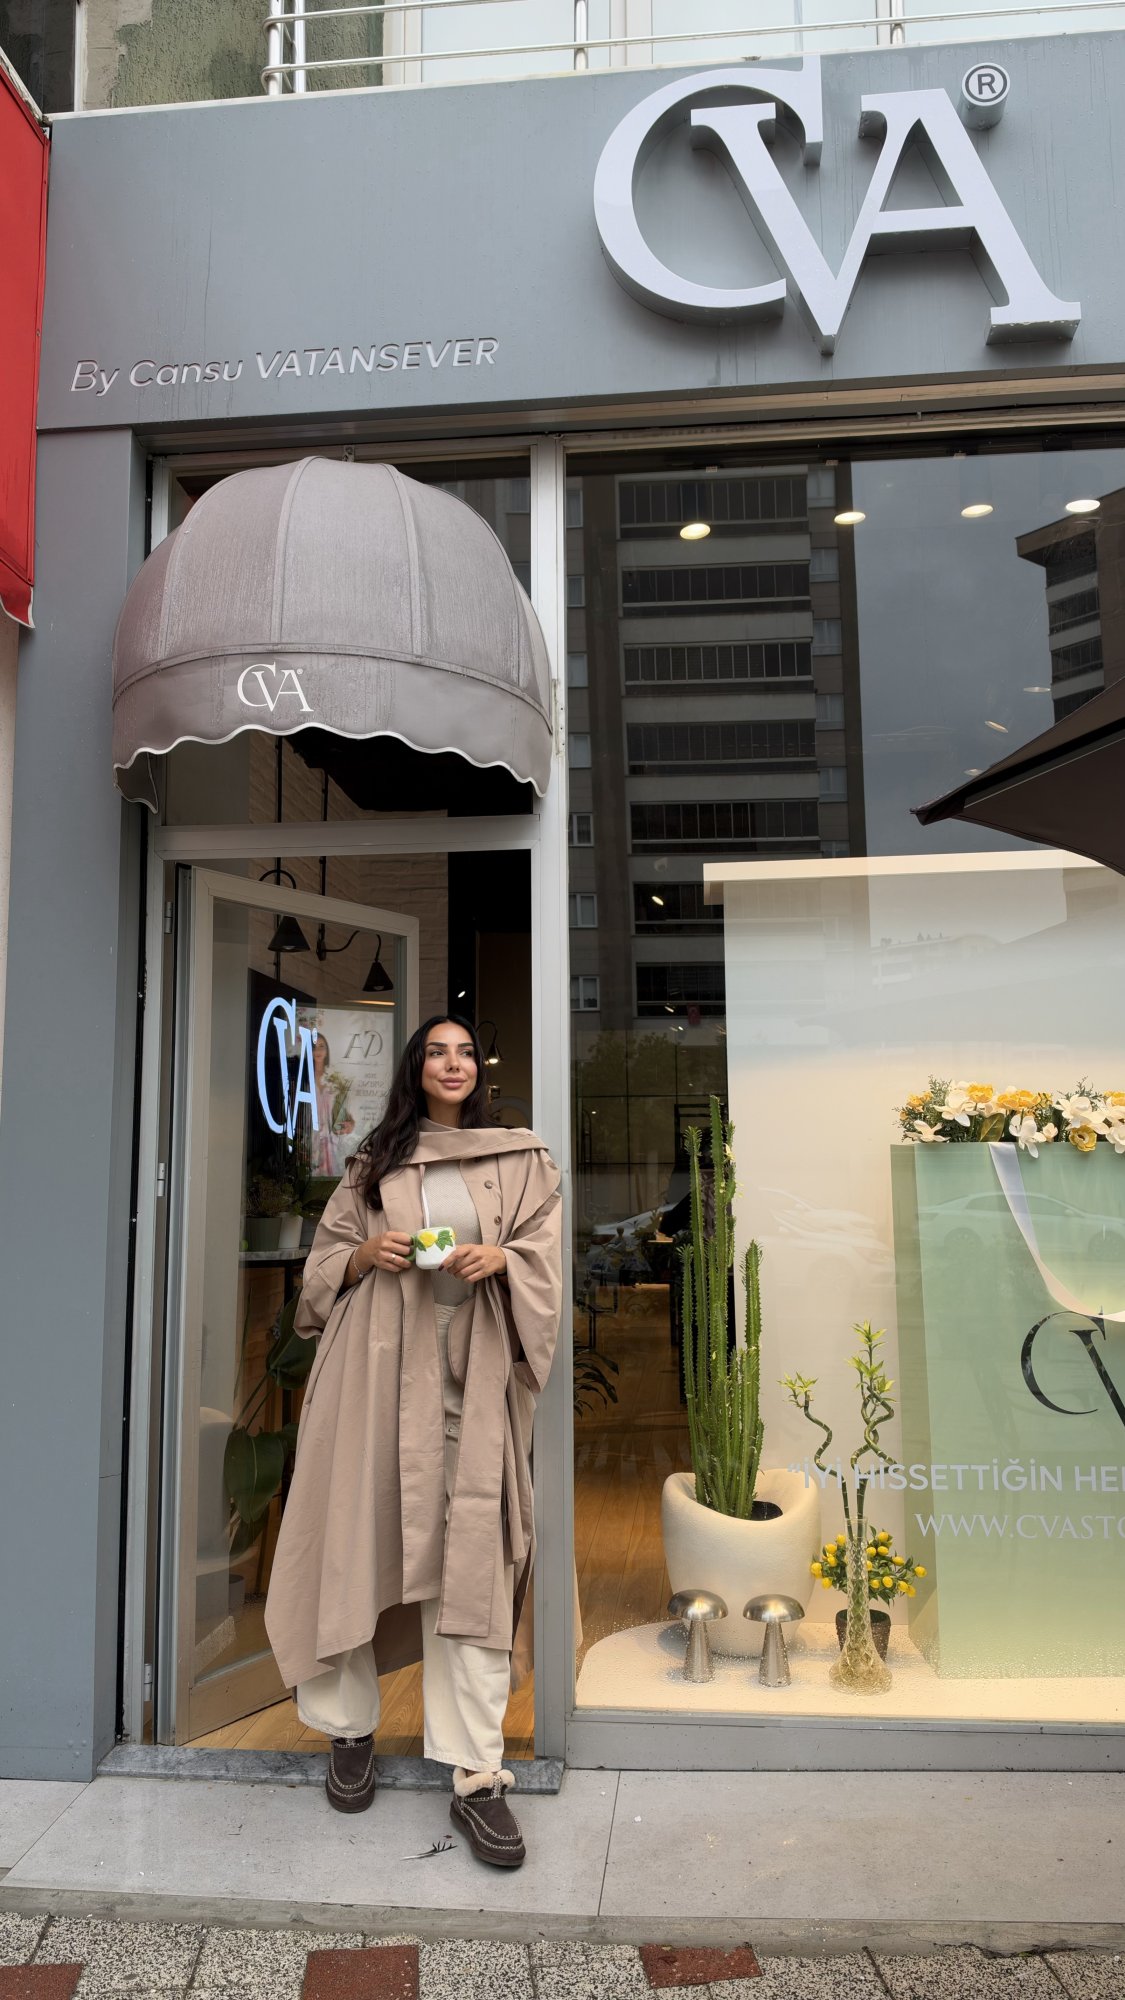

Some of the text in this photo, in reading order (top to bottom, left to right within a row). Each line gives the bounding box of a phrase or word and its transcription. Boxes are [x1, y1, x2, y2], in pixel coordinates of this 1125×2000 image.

[70, 337, 500, 396] By Cansu VATANSEVER
[854, 1457, 1063, 1491] HİSSETTİĞİN
[1074, 1465, 1125, 1492] HE
